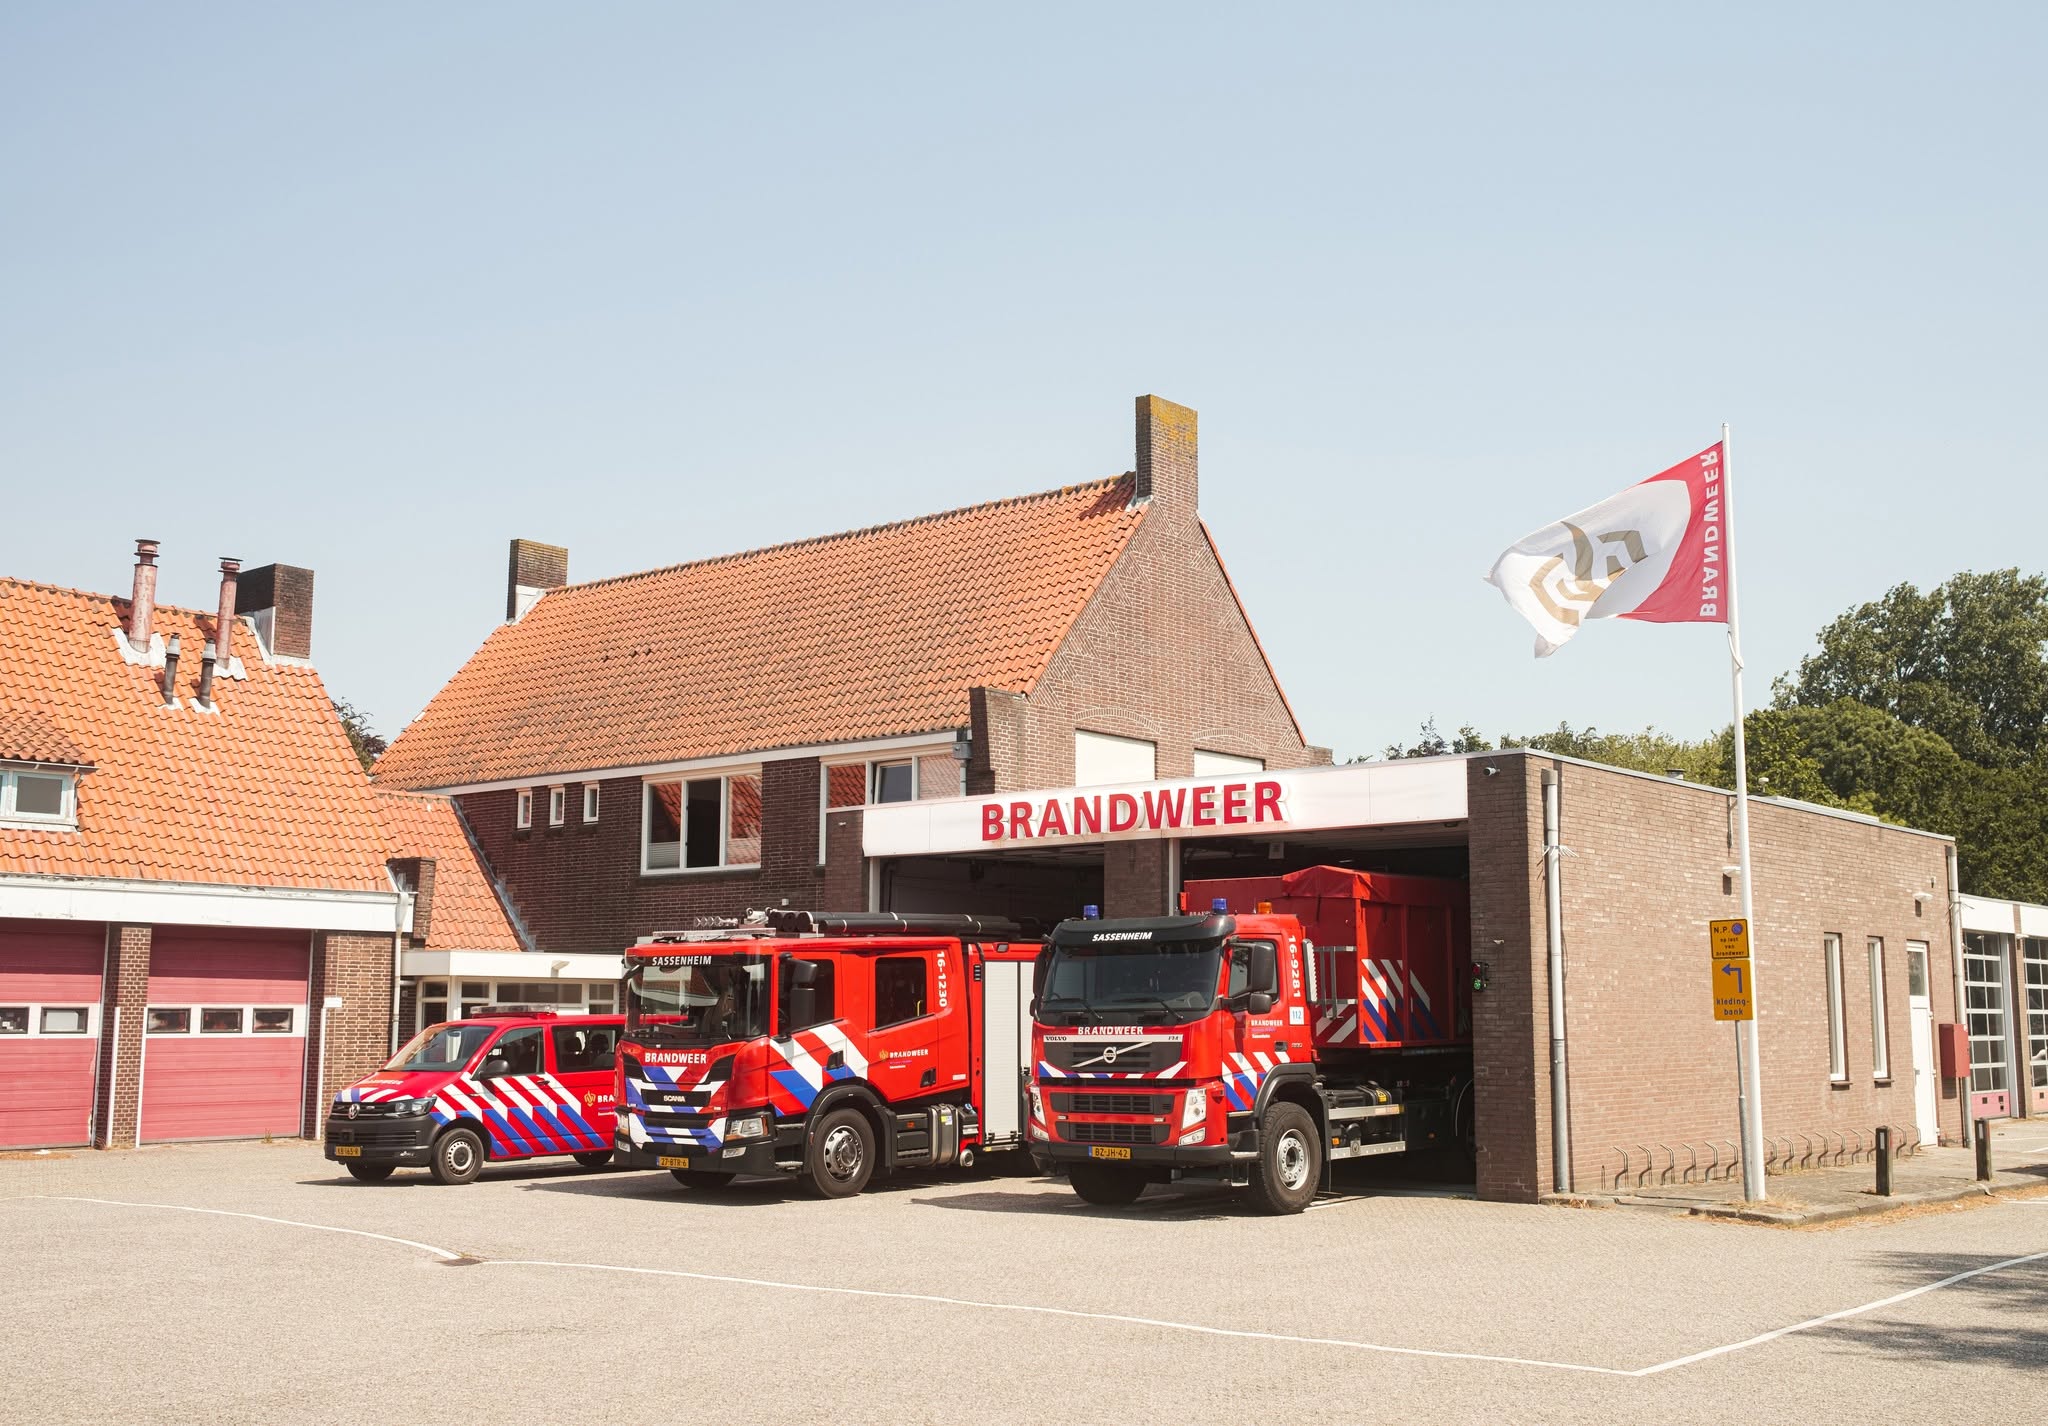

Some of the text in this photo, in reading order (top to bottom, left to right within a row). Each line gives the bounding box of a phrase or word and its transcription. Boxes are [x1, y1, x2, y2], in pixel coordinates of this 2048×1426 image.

[981, 781, 1284, 842] BRANDWEER
[1092, 931, 1153, 941] SASSENHEIM
[652, 956, 712, 965] SASSENHEIM
[1288, 935, 1301, 998] 16-9281
[937, 951, 948, 1007] 16-1230
[1292, 1010, 1302, 1019] 112
[1078, 1026, 1144, 1035] BRANDWEER
[889, 1049, 928, 1058] BRANDWEER
[644, 1053, 707, 1064] BRANDWEER
[597, 1095, 615, 1103] BRA
[1095, 1148, 1128, 1157] BZ-JH-42
[661, 1157, 687, 1166] 27-BTR-6
